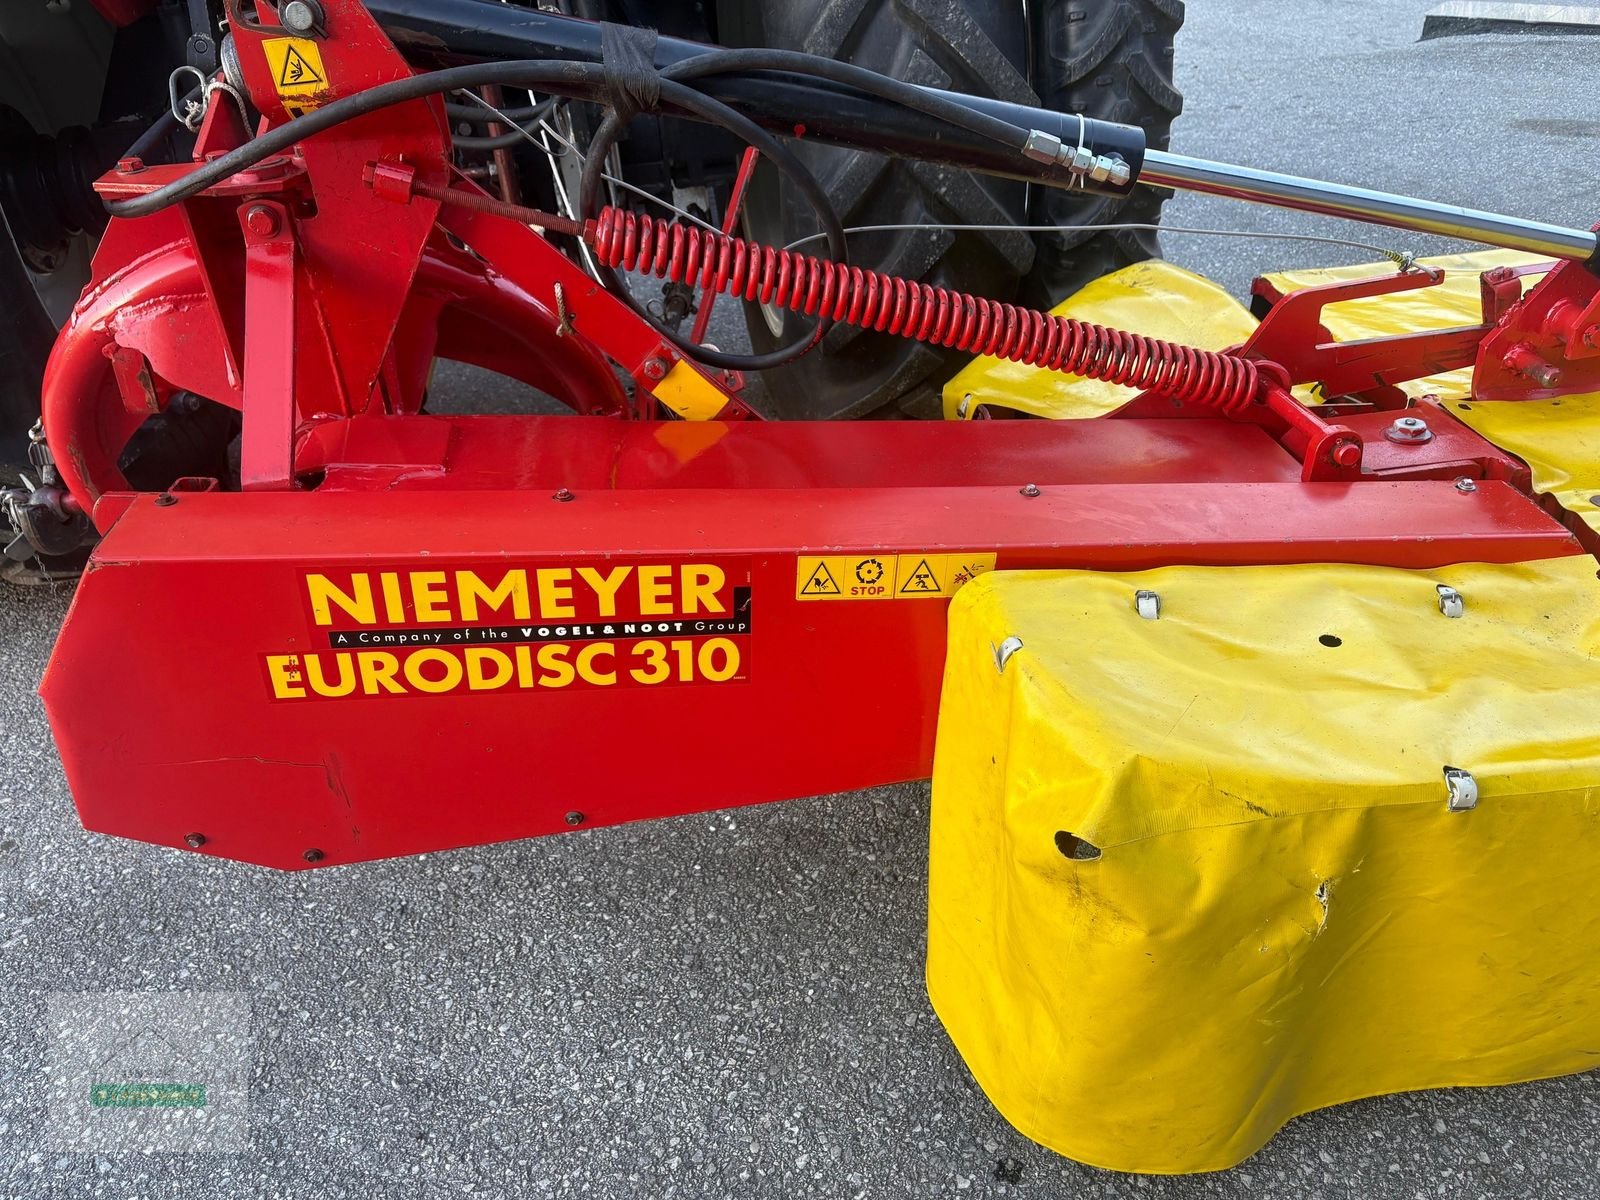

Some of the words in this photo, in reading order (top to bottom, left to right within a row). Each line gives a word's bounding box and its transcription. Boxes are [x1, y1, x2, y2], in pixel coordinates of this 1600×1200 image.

[306, 564, 726, 625] NIEMEYER
[850, 586, 885, 596] STOP
[337, 634, 348, 643] A
[359, 633, 442, 644] Company
[453, 629, 471, 640] of
[481, 628, 508, 639] the
[521, 625, 594, 637] VOGEL
[602, 624, 615, 634] &
[624, 623, 682, 634] NOOT
[695, 621, 746, 632] Group
[266, 642, 617, 699] EURODISC
[629, 637, 740, 685] 310
